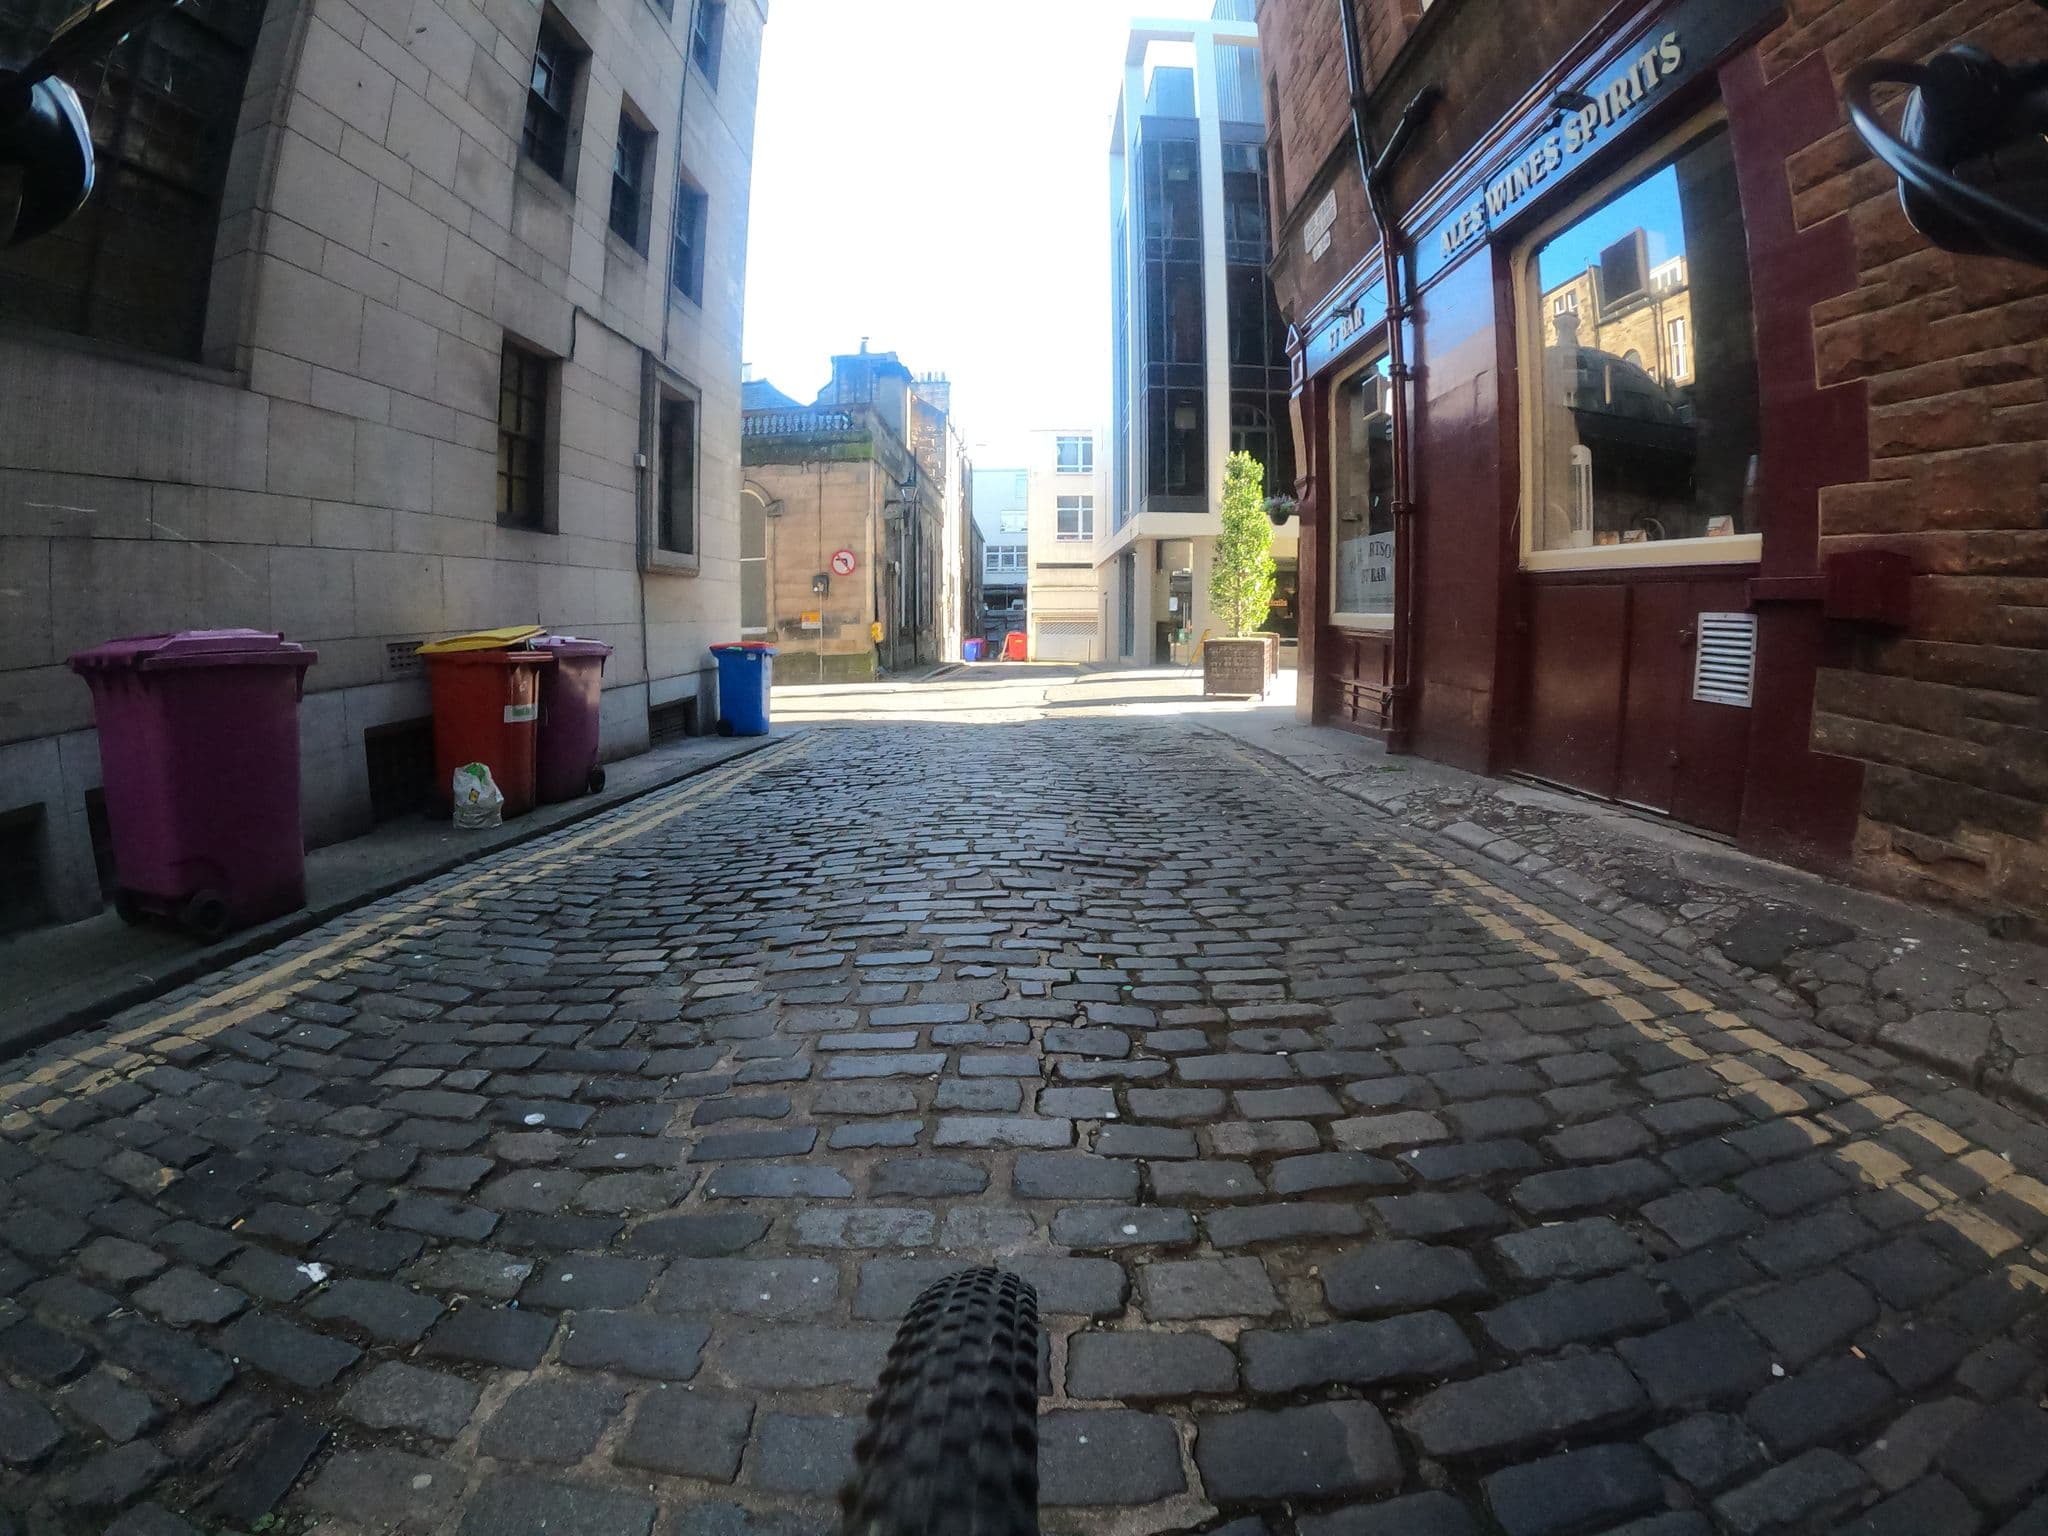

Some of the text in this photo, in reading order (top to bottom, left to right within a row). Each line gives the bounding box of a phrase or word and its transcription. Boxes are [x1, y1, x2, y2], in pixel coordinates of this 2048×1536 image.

[1440, 31, 1682, 258] ALES WINES SPIRITS
[1341, 307, 1364, 340] BAR
[1370, 566, 1386, 582] BAR
